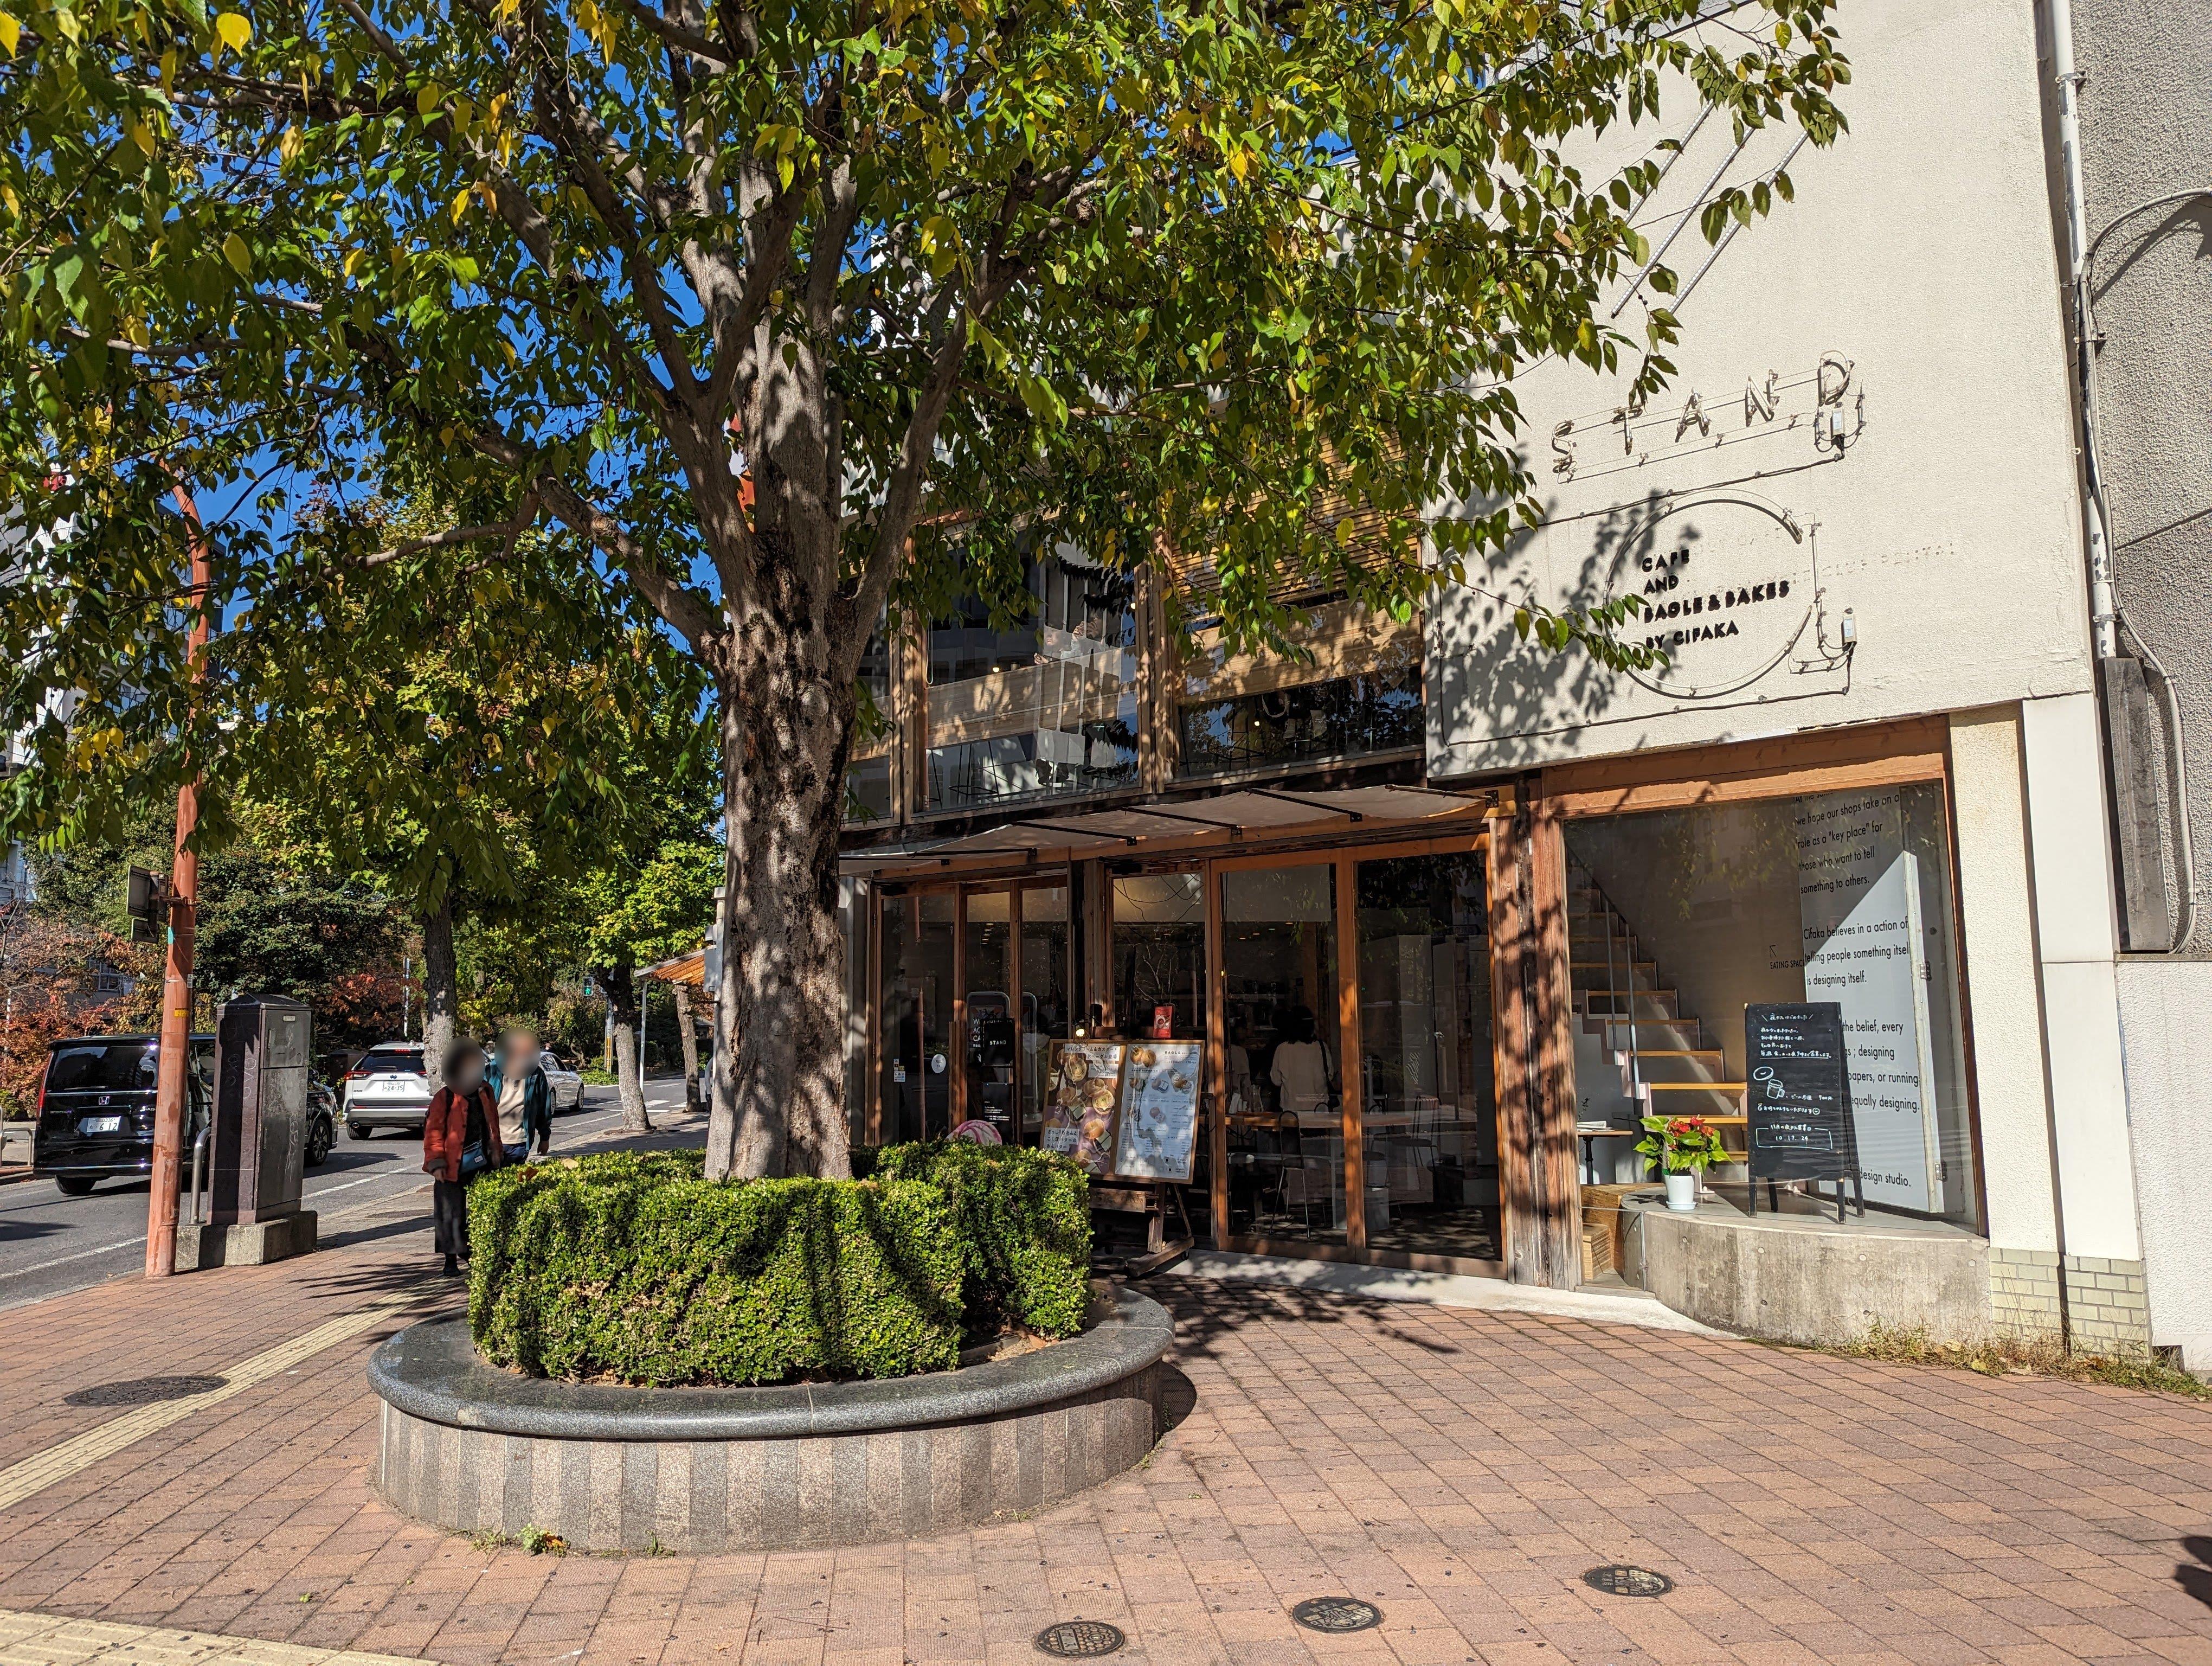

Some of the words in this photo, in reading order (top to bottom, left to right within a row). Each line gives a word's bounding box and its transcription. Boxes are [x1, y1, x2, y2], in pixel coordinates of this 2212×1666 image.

[1552, 349, 1855, 470] STAND
[1642, 549, 1690, 573] CAFE
[1643, 574, 1679, 595] AND
[1644, 595, 1702, 624] BAGLE
[1725, 580, 1790, 608] BAKES
[1645, 635, 1665, 650] BY
[1673, 620, 1739, 646] CIFAKA
[1796, 817, 1805, 826] we
[1808, 812, 1824, 825] hope
[1827, 809, 1838, 819] our
[1841, 803, 1861, 816] shops
[1863, 796, 1880, 810] take
[1882, 796, 1892, 806] on
[1894, 794, 1899, 803] a
[1798, 838, 1810, 849] role
[1812, 836, 1820, 845] as
[1822, 835, 1827, 844] a
[1828, 830, 1844, 844] "key
[1847, 824, 1869, 841] place"
[1872, 822, 1883, 834] for
[1798, 861, 1816, 872] those
[1818, 857, 1832, 867] who
[1835, 852, 1853, 863] want
[1854, 851, 1862, 861] to
[1863, 847, 1875, 860] tell
[1801, 878, 1834, 894] something
[1836, 879, 1843, 888] to
[1845, 874, 1870, 886] others.
[1803, 927, 1824, 940] Cifaka
[1827, 925, 1855, 937] believes
[1857, 922, 1864, 934] in
[1866, 925, 1872, 933] a
[1874, 919, 1898, 933] action
[1900, 916, 1908, 930] of
[1805, 950, 1825, 964] telling
[1827, 947, 1851, 964] people
[1853, 944, 1891, 960] something
[1893, 941, 1910, 956] itsel
[1770, 960, 1789, 970] EATING
[1806, 976, 1811, 985] is
[1813, 972, 1846, 987] designing
[1848, 970, 1867, 984] itself.
[1842, 1020, 1854, 1033] the
[1856, 1020, 1880, 1035] belief,
[1881, 1021, 1904, 1036] every
[1858, 1045, 1895, 1061] designing
[1877, 1072, 1887, 1082] or
[1888, 1072, 1919, 1088] running
[1879, 1095, 1920, 1113] designing.
[1859, 1167, 1883, 1183] design
[1885, 1172, 1911, 1188] studio.
